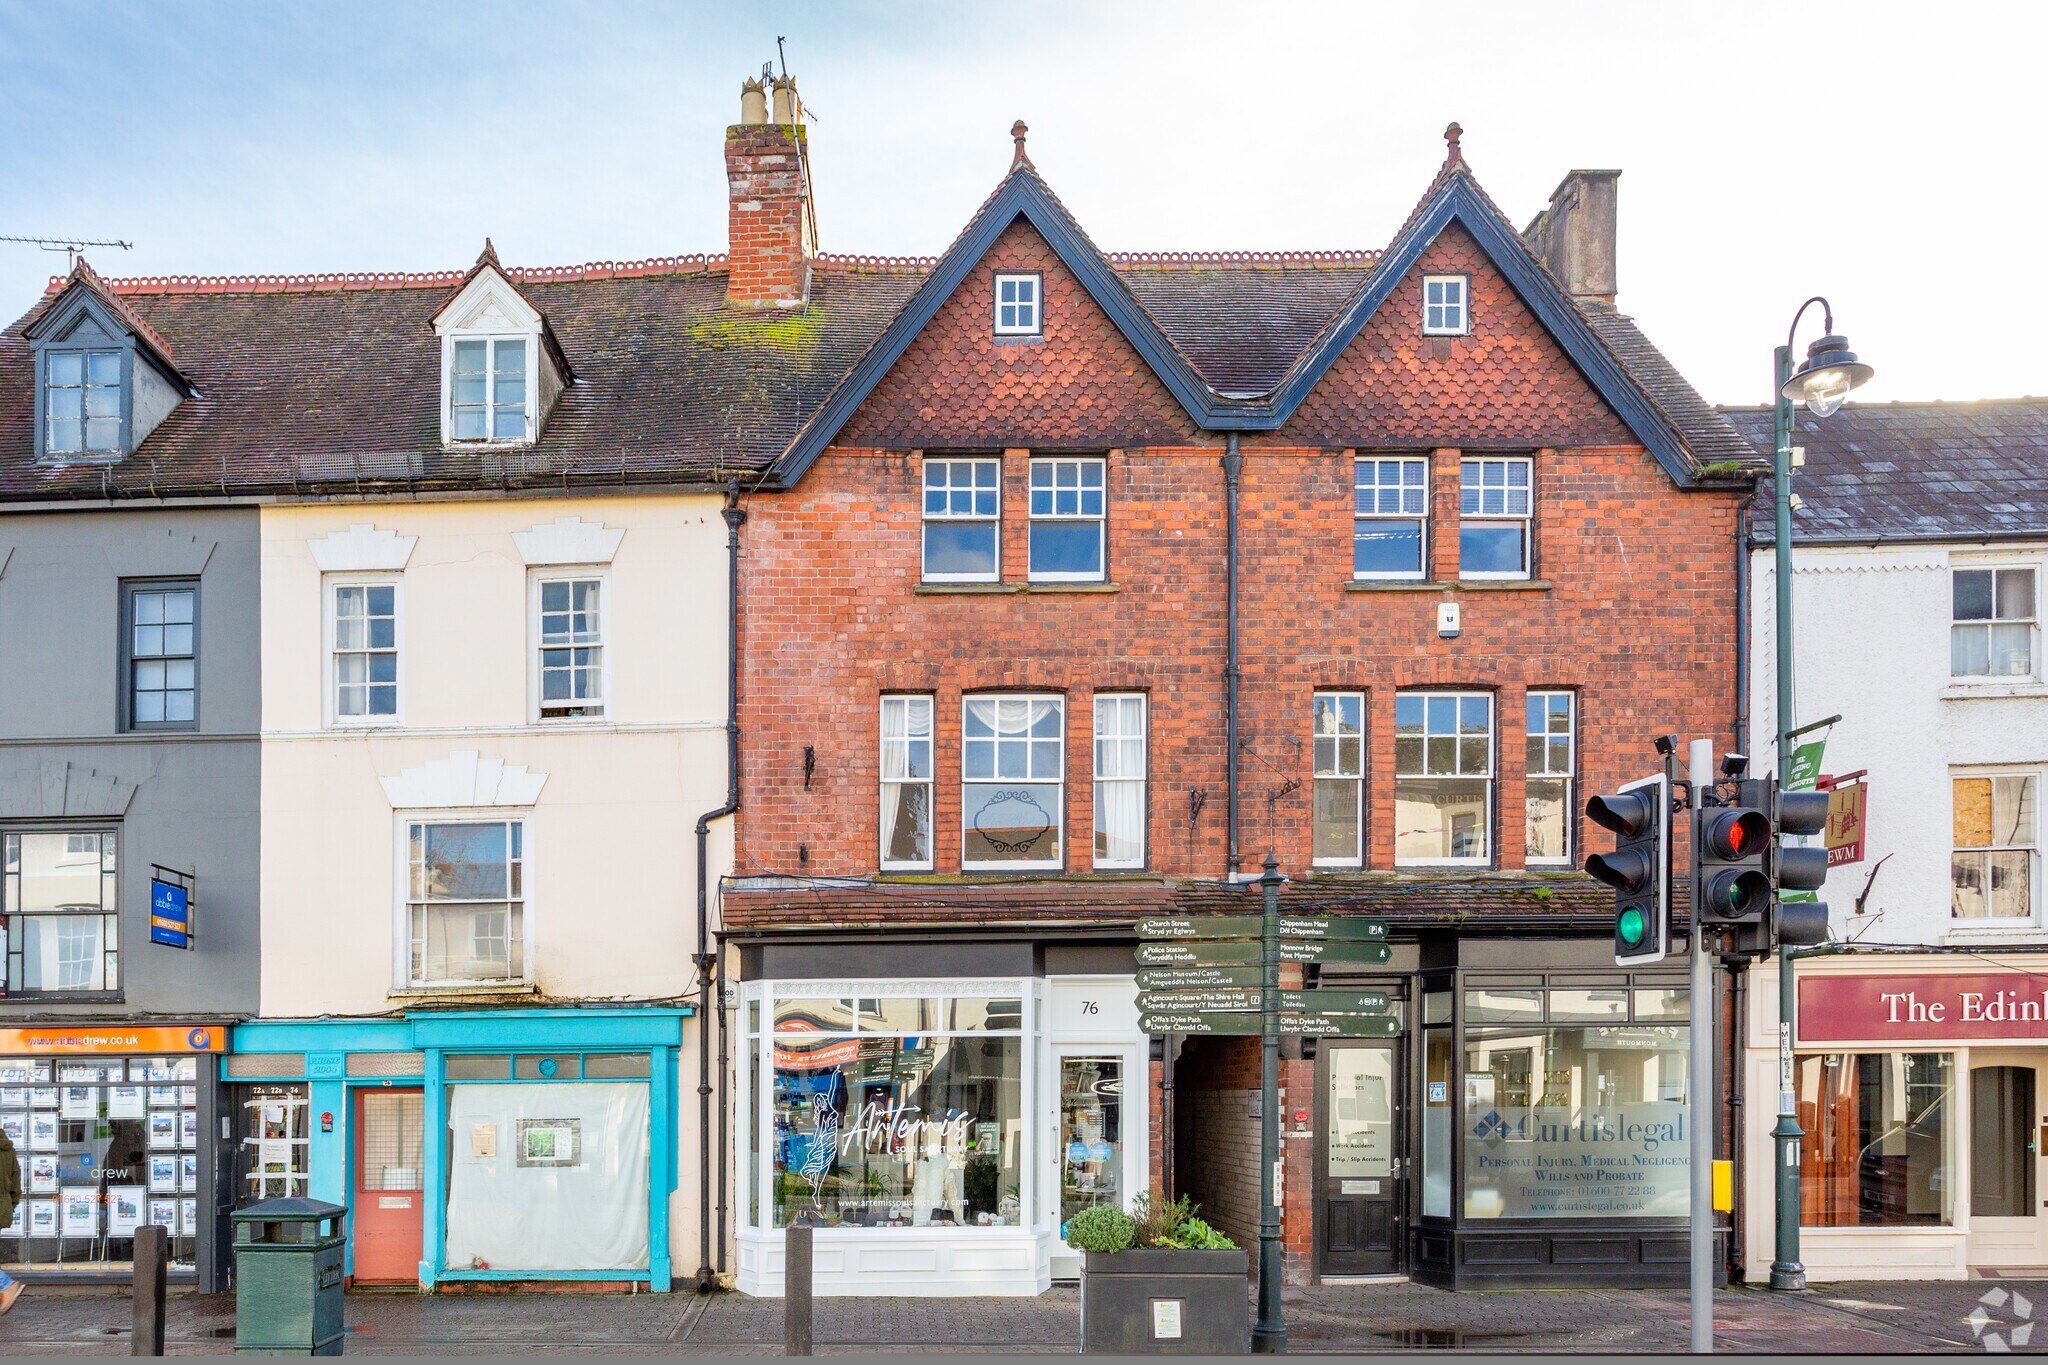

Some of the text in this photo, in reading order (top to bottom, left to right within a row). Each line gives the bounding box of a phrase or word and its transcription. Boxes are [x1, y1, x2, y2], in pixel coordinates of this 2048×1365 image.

[1280, 920, 1313, 928] Chippenham
[1147, 954, 1173, 962] Swyddfa
[1294, 952, 1314, 960] Mynwy
[1150, 979, 1185, 987] Amgueddfa
[1179, 993, 1215, 1001] Square/The
[1082, 1001, 1098, 1014] 76
[1167, 1001, 1206, 1009] Agincourt/Y
[1880, 991, 1946, 1023] The
[1170, 1016, 1186, 1024] Dyke
[27, 1034, 139, 1046] www.abbiedrew.co.uk
[843, 1101, 976, 1156] Artemis
[1518, 1112, 1684, 1152] Curtislegal
[1479, 1155, 1533, 1168] PERSONAL
[1580, 1154, 1629, 1167] MEDICAL
[46, 1163, 129, 1179] abbiedrew
[1535, 1169, 1644, 1181] WILLS AND PROBATE
[1578, 1186, 1610, 1196] 01600
[1613, 1186, 1625, 1196] 77
[1627, 1186, 1640, 1196] 22
[1642, 1186, 1656, 1196] 88
[838, 1199, 969, 1207] www.artemissoulsanctuary.com
[1531, 1200, 1645, 1213] www.curtislegal.co.uk
